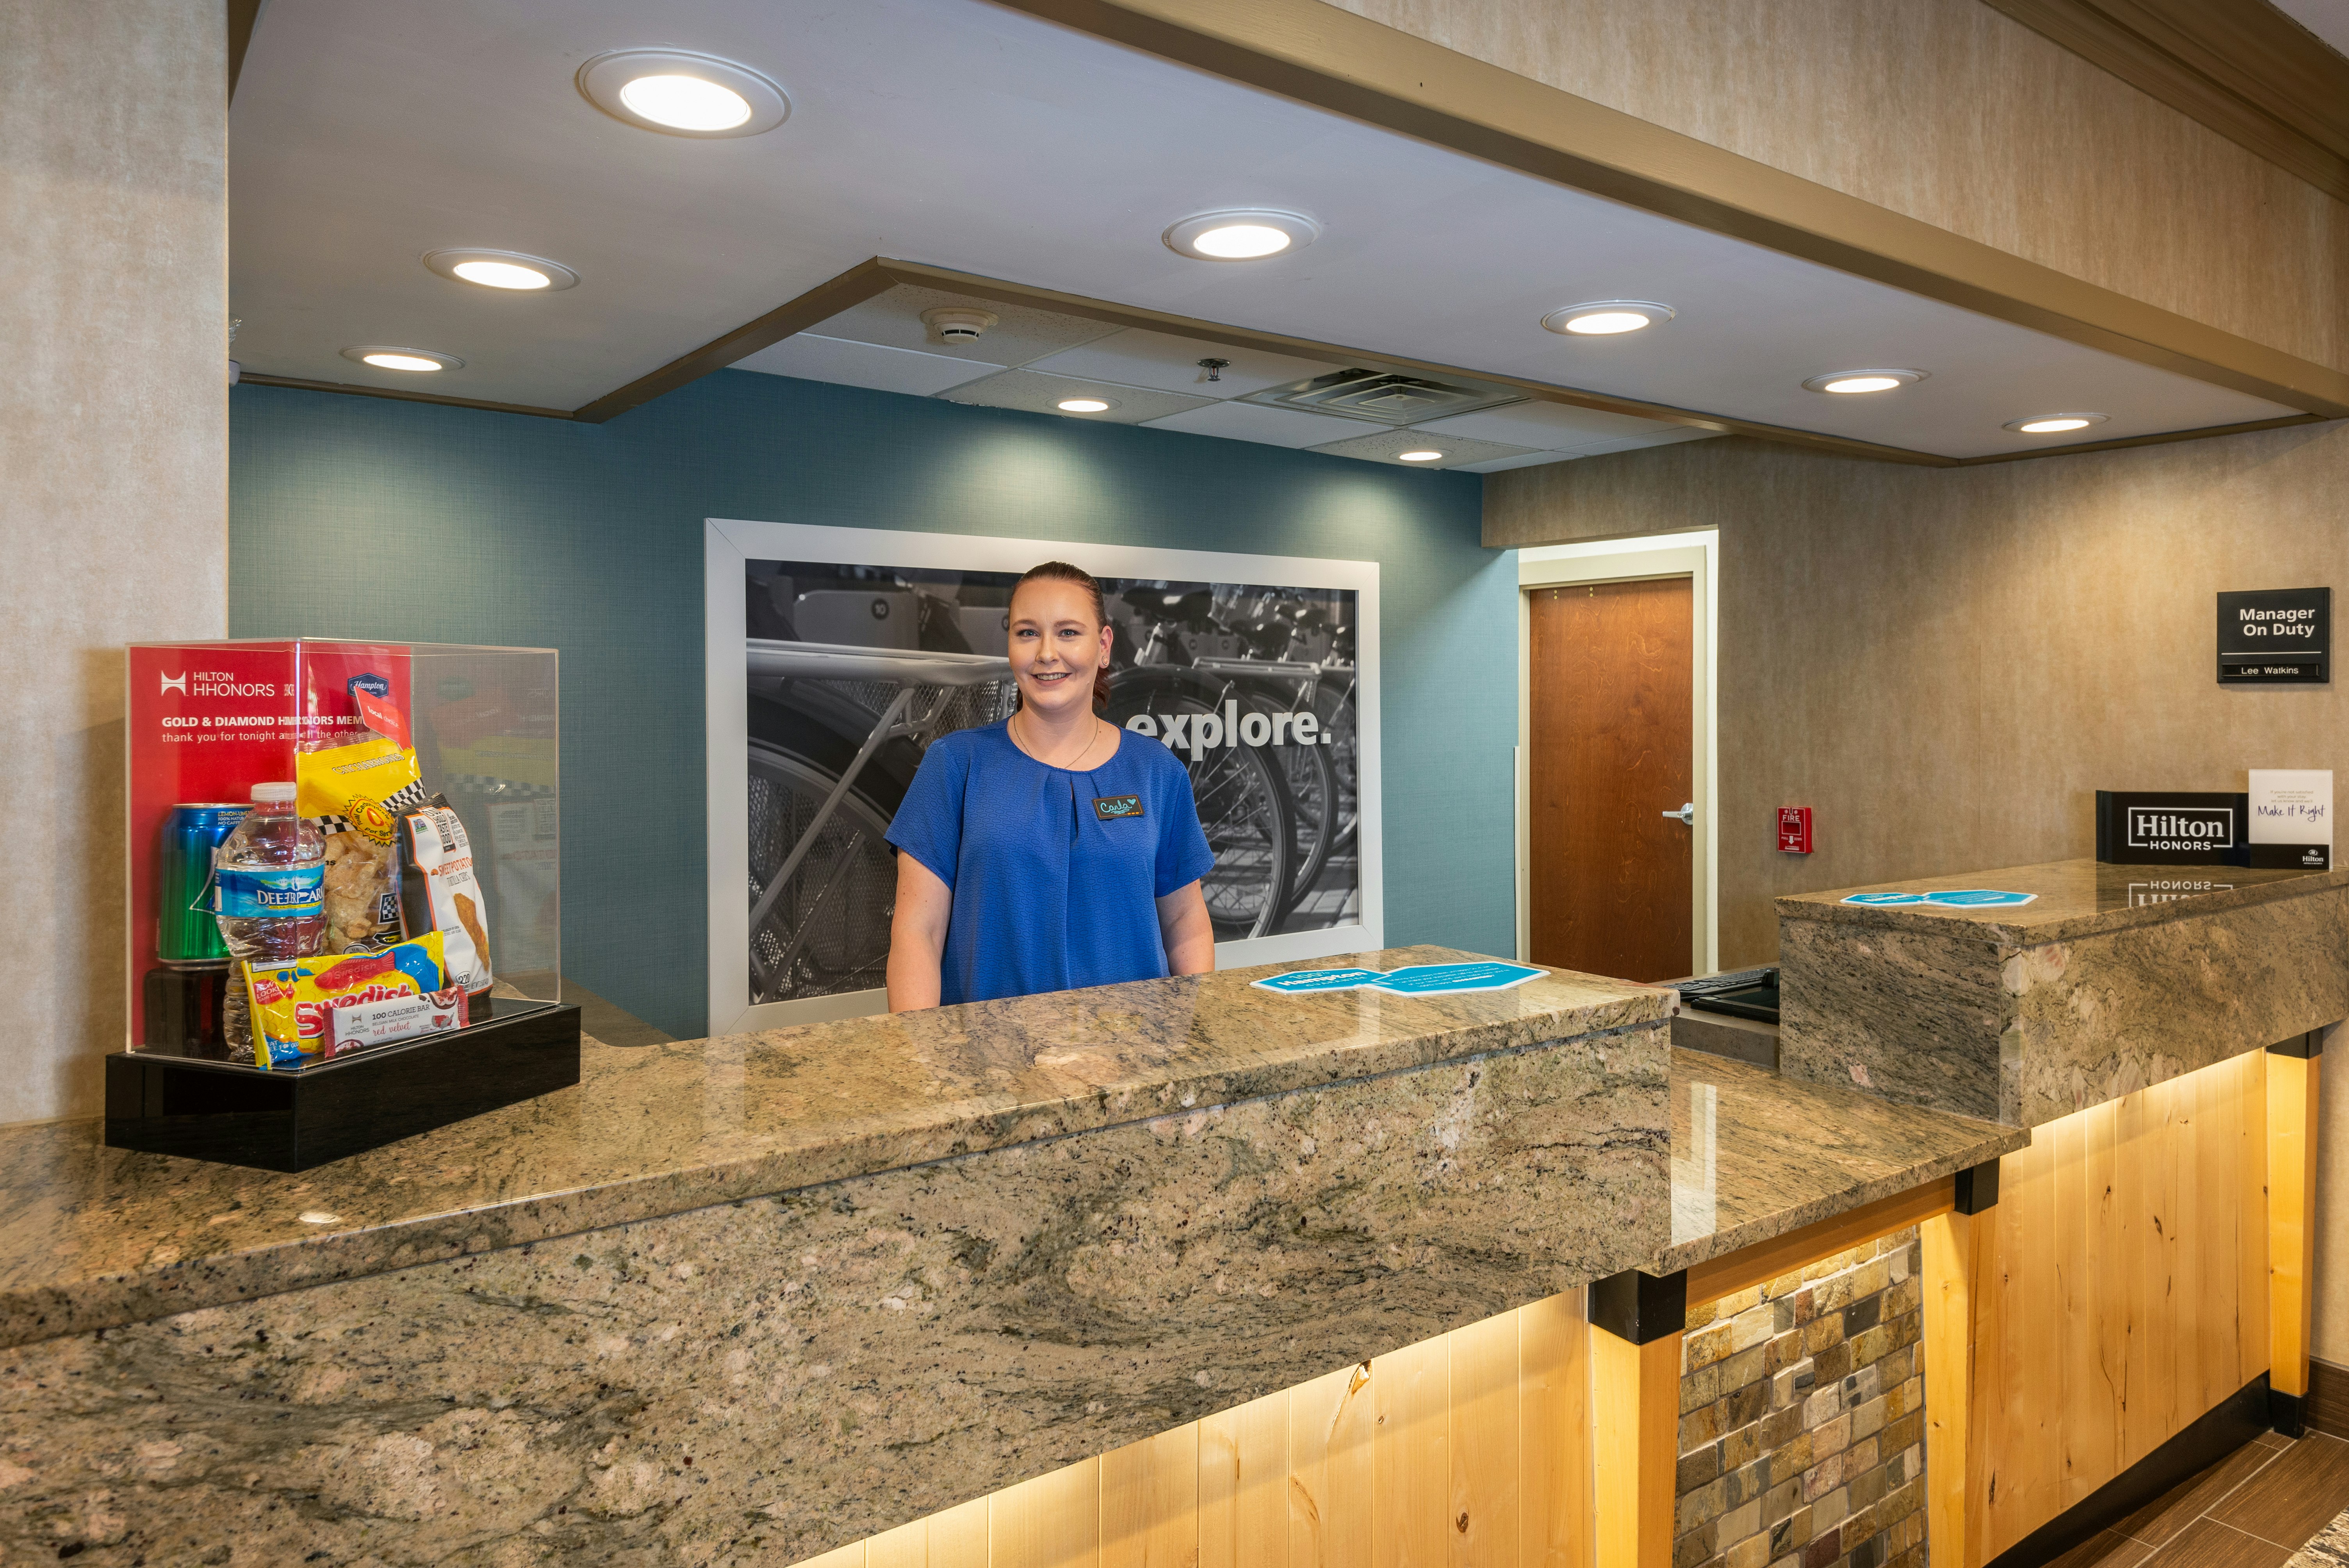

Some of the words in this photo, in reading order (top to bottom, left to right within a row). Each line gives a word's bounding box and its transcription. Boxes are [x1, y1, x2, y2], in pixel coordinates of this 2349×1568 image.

[2240, 609, 2315, 622] Manager
[2243, 624, 2267, 636] On
[2273, 623, 2315, 638] Duty
[194, 672, 233, 681] HILTON
[194, 683, 275, 697] HHONORS
[354, 680, 387, 691] Hampton
[367, 706, 383, 720] local
[162, 717, 198, 727] GOLD
[202, 717, 211, 727] &
[215, 716, 275, 726] DIAMOND
[162, 732, 194, 742] thank
[197, 734, 216, 743] you
[220, 732, 235, 740] for
[239, 731, 276, 742] tonight
[317, 730, 331, 738] the
[334, 729, 358, 738] other
[1125, 699, 1331, 761] explore.
[332, 753, 405, 775] CHICHARRONES
[1100, 799, 1132, 813] Carla
[2258, 805, 2285, 817] Make
[2288, 804, 2296, 817] It
[2300, 804, 2326, 822] Right
[438, 823, 449, 833] TASTE
[2137, 815, 2224, 837] Hilton
[2150, 841, 2211, 850] HONORS
[458, 973, 470, 984] 220
[1276, 971, 1368, 986] Hampton
[1305, 976, 1367, 987] GUARANTEE
[296, 983, 414, 1039] Swedish
[372, 1012, 387, 1020] 100
[387, 1007, 416, 1017] CALORIE
[345, 1028, 370, 1036] HHONORS
[372, 1025, 387, 1037] red
[389, 1021, 412, 1033] velvet
